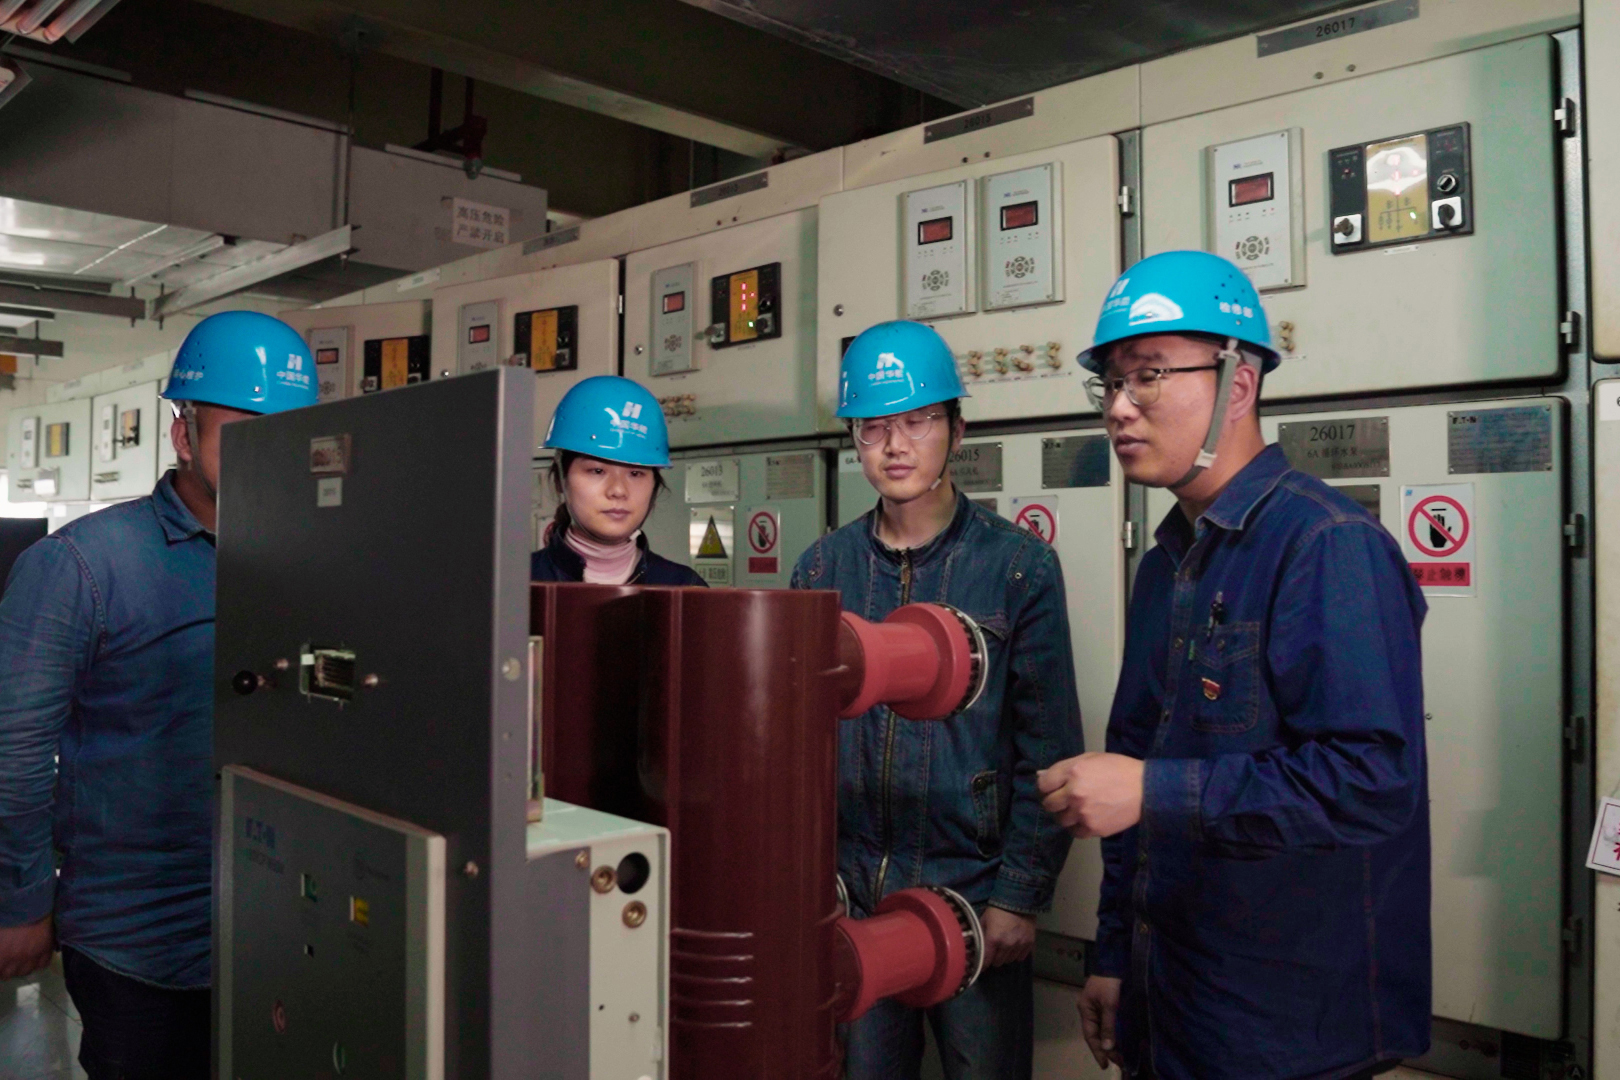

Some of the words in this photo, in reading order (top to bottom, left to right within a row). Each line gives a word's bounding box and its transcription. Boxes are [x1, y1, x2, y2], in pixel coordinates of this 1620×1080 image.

[1315, 17, 1356, 38] 26017
[1310, 424, 1355, 442] 26017
[948, 448, 980, 463] 26015
